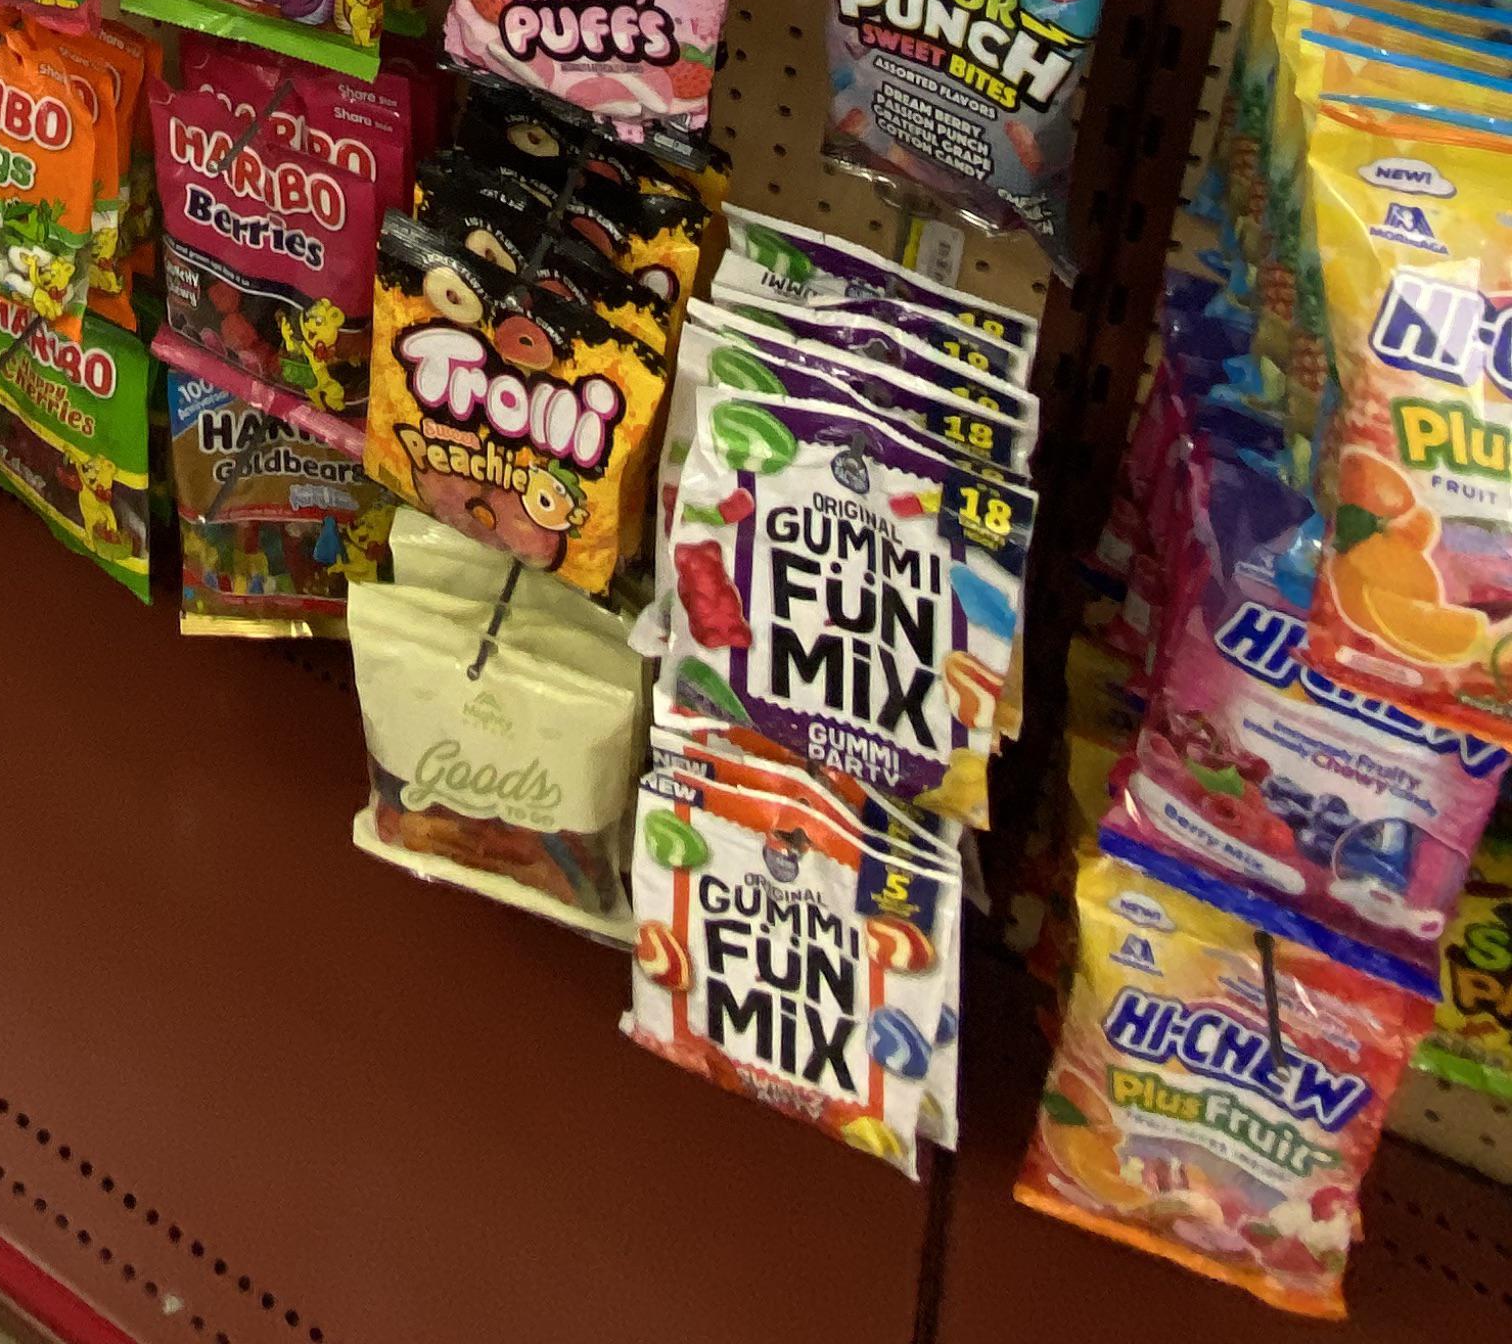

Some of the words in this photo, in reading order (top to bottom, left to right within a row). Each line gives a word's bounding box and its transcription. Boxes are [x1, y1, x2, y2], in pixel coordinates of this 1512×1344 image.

[503, 5, 673, 60] PUFFS
[861, 21, 946, 68] SWEET
[949, 56, 1018, 110] BITES
[874, 57, 938, 93] ASSORTED
[940, 86, 997, 120] FLAVORS
[877, 93, 935, 132] PASSION
[938, 123, 990, 156] PUNCH
[883, 84, 933, 113] DREAM
[934, 109, 983, 139] BERRY
[169, 116, 346, 232] HARIBO
[1376, 166, 1434, 187] NEW!
[185, 183, 325, 272] Berries
[400, 327, 619, 466] Trolli
[944, 414, 995, 451] 18
[214, 448, 366, 485] Goldbears
[1431, 474, 1499, 504] FRUIT
[813, 491, 903, 546] ORIGINAL
[958, 486, 1013, 535] 18
[766, 504, 941, 596] GUMMI
[405, 739, 562, 811] Goods
[808, 720, 900, 771] GUMMI
[698, 874, 860, 961] GUMMI
[1104, 985, 1372, 1133] HI-CHEW
